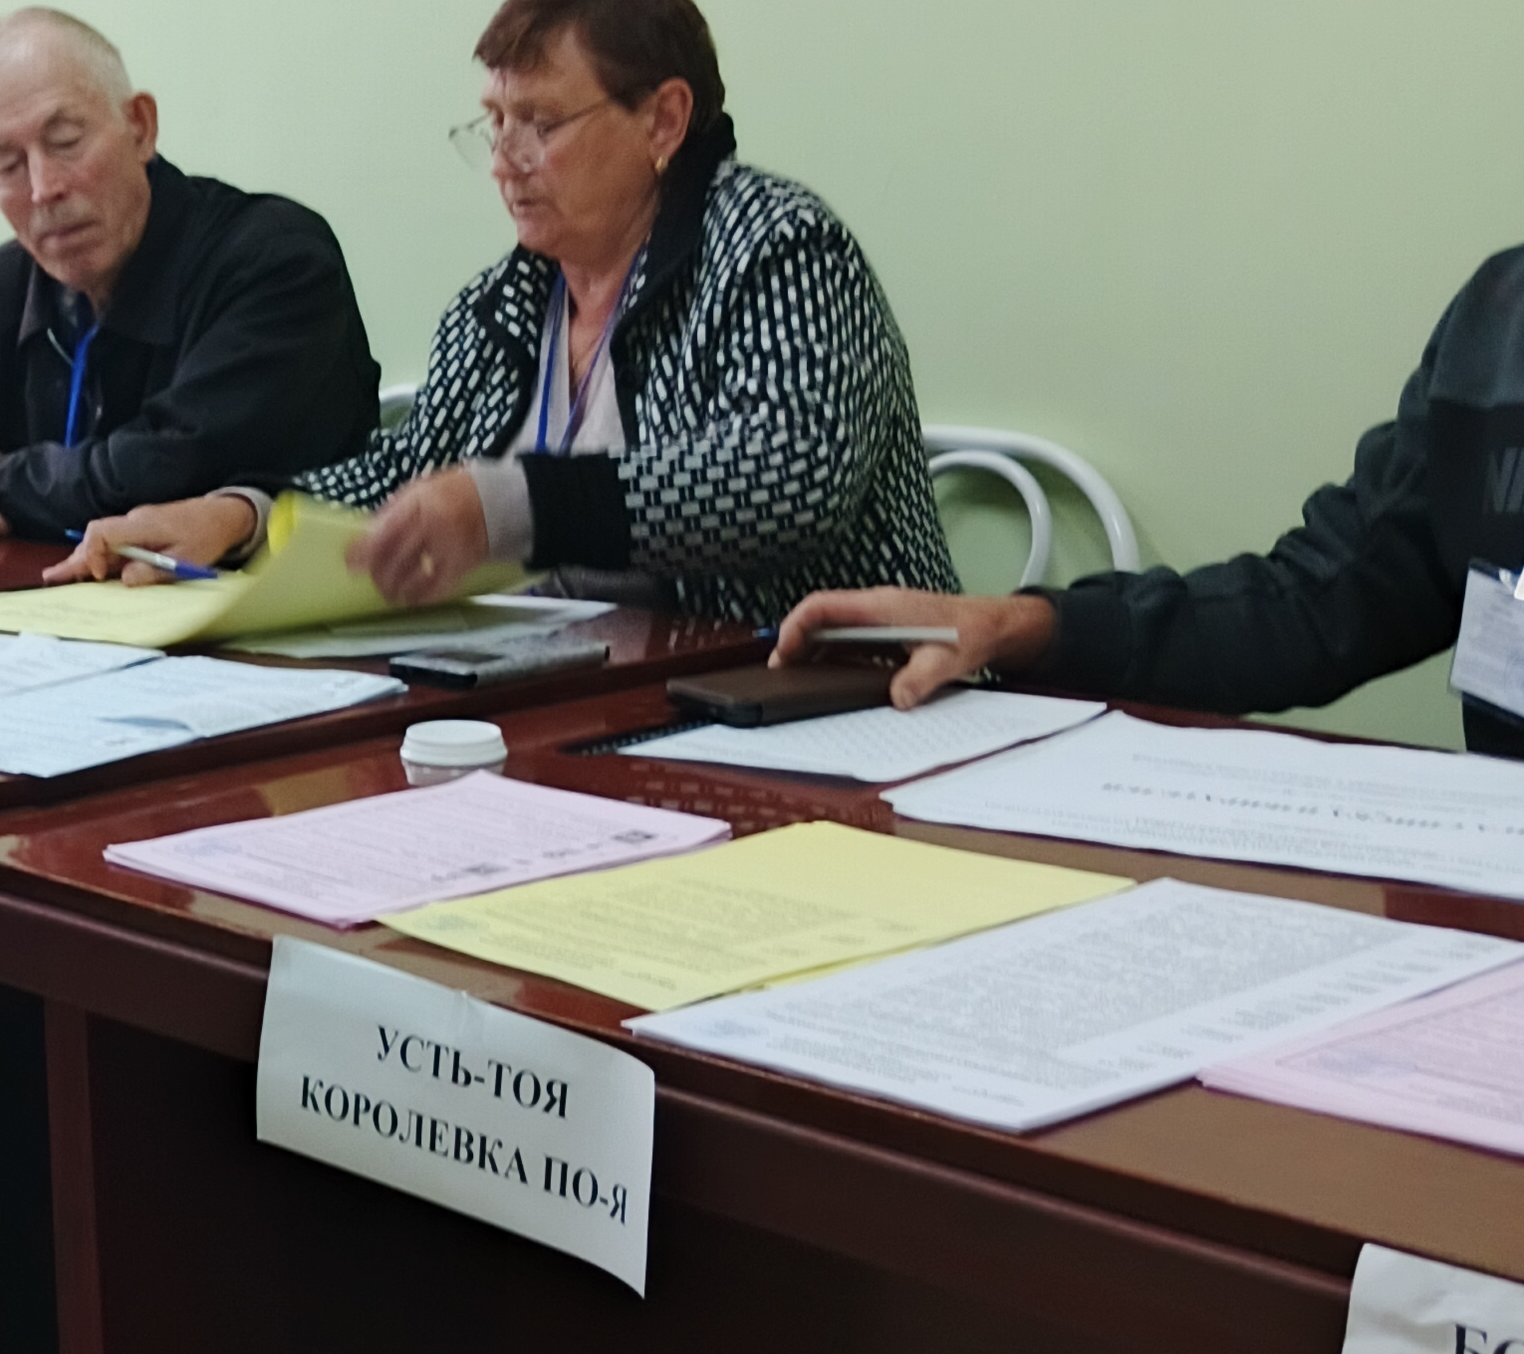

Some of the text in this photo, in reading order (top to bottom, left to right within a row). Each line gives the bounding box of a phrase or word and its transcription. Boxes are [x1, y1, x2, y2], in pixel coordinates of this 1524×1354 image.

[377, 1024, 570, 1120] УСТЬ-ТОЯ
[301, 1075, 629, 1226] КОРОЛЕВКА ПО-Я
